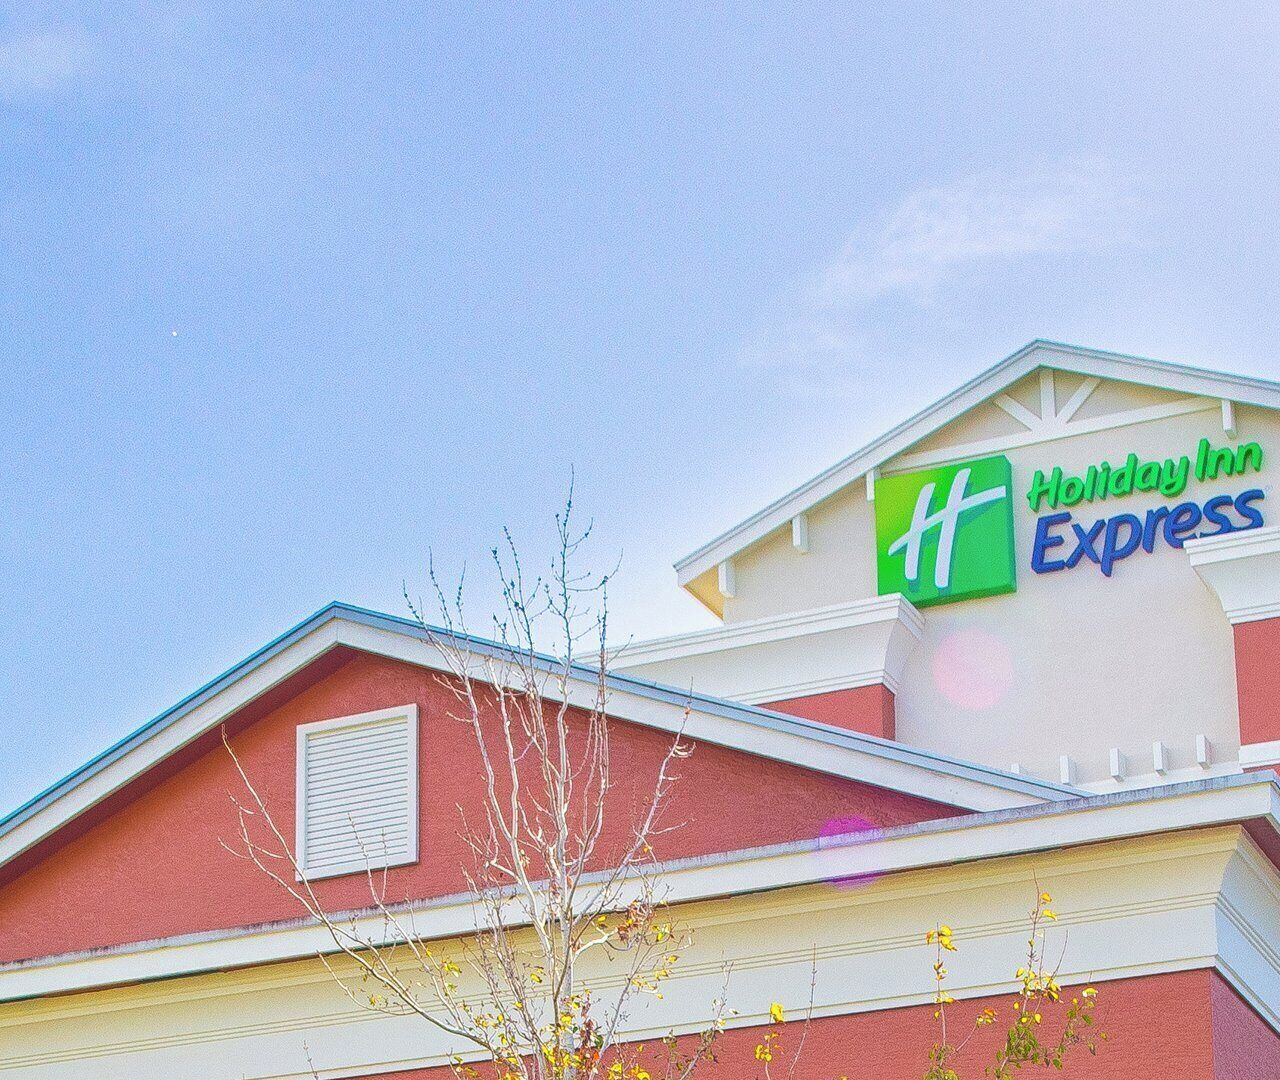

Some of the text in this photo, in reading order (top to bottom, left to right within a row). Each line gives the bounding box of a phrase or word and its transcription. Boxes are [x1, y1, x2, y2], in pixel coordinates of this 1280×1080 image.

[1026, 437, 1263, 513] Holiday Inn
[1031, 488, 1265, 577] Express
